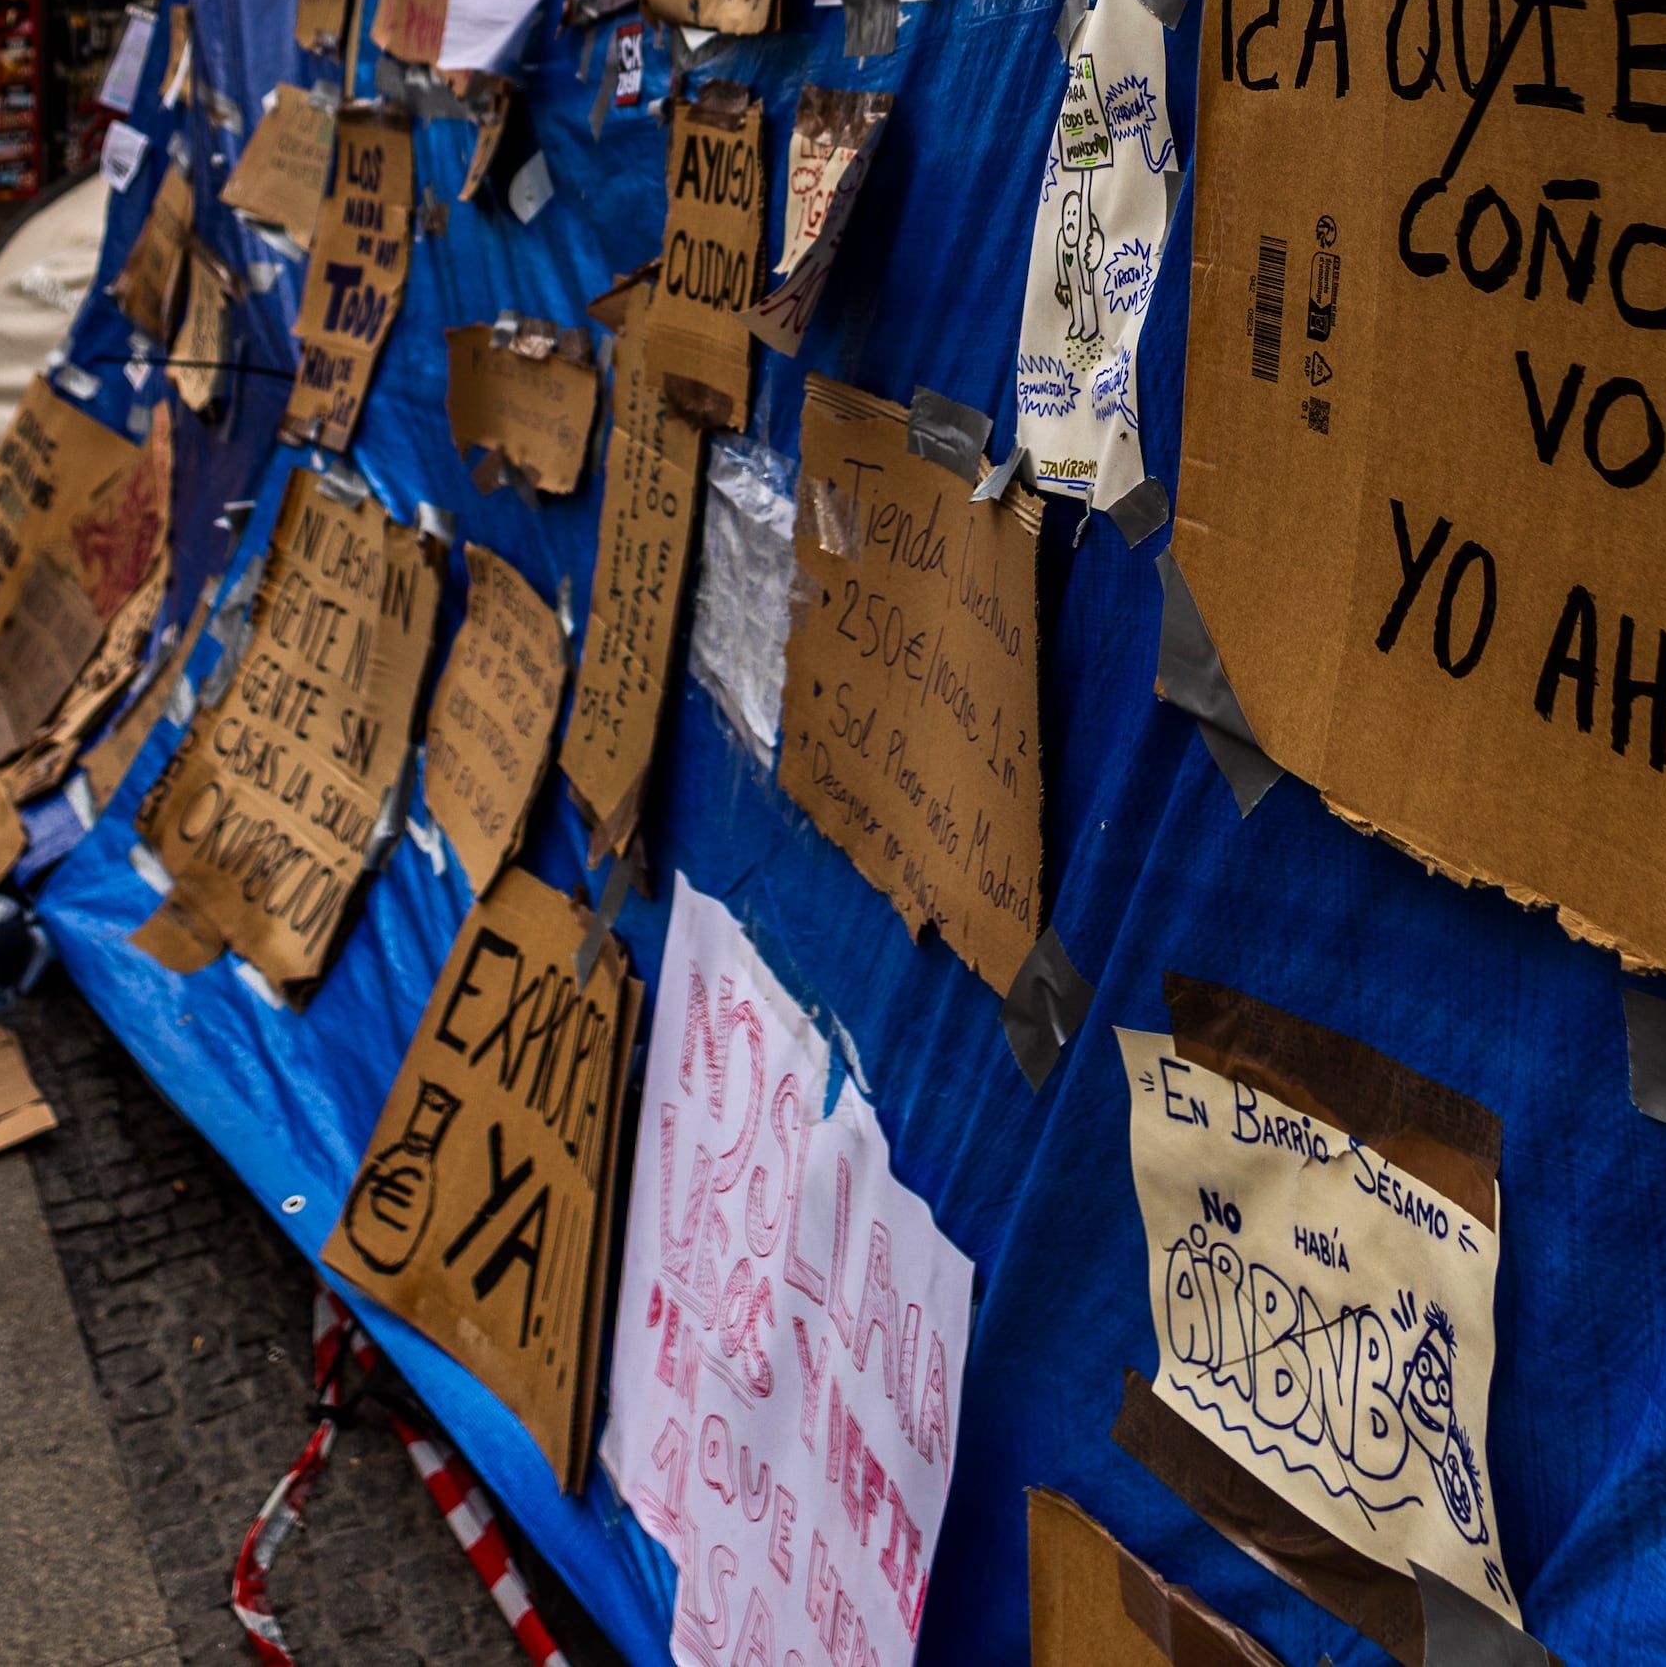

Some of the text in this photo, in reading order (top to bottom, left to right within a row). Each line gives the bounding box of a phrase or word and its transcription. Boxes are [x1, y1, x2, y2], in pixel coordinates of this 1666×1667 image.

[1061, 108, 1099, 130] TODO EL
[346, 141, 384, 193] LOS
[673, 133, 756, 214] AYUSO
[324, 261, 387, 345] TODO
[1304, 354, 1312, 378] PAP
[291, 504, 327, 563] NI
[844, 458, 950, 580] Tienda
[270, 571, 348, 673] GENTE
[1375, 497, 1496, 679] YO
[241, 653, 326, 742] GENTE
[290, 758, 311, 816] LA
[884, 728, 1034, 933] Pleno Madrid
[1160, 1056, 1209, 1130] EN
[1230, 1079, 1331, 1166] BARRIO
[1200, 1187, 1351, 1274] NO HABÍA
